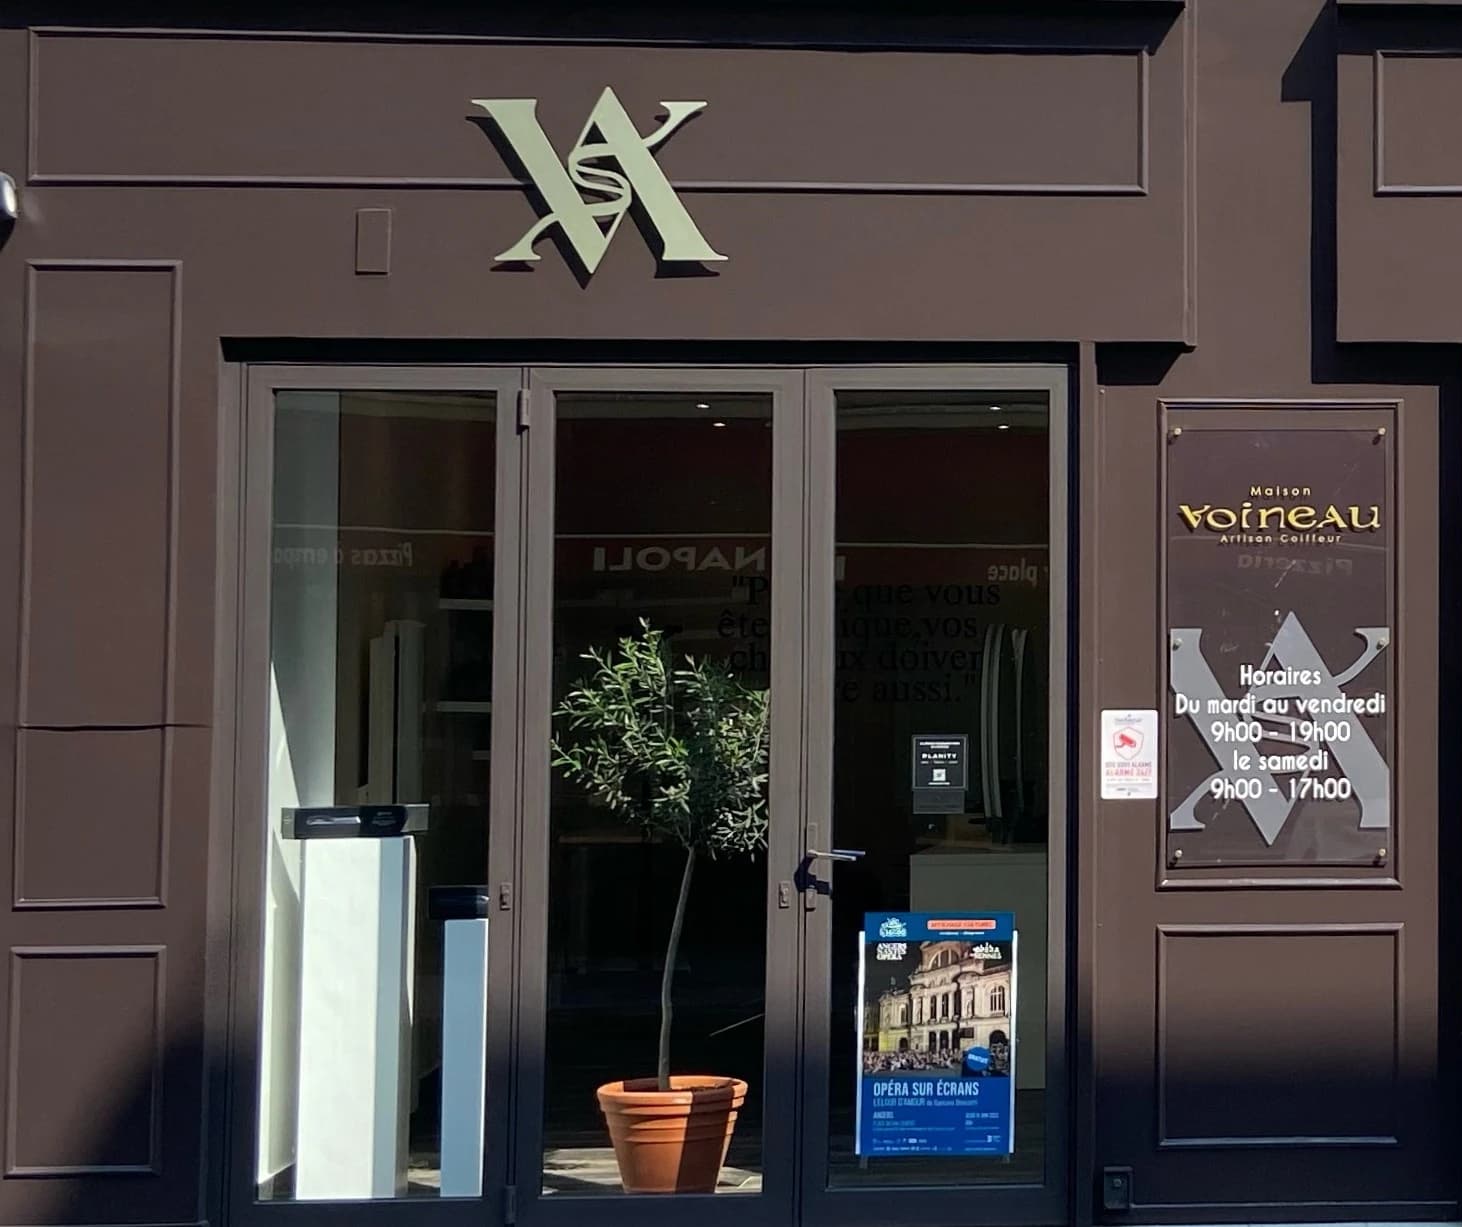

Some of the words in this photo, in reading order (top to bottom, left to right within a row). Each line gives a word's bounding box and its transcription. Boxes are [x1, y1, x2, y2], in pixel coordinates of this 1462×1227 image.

[1250, 486, 1312, 497] Maison
[1220, 534, 1273, 544] Artisan
[1280, 534, 1342, 544] Coiffeur
[926, 584, 1001, 606] vous
[1240, 665, 1322, 686] Horaires
[1175, 693, 1200, 714] Du
[1207, 693, 1256, 714] mardi
[1262, 699, 1289, 714] au
[1296, 692, 1386, 714] vendredi
[1210, 721, 1263, 742] 9h00
[1290, 721, 1351, 742] 19h00
[1233, 749, 1251, 770] le
[1258, 749, 1328, 770] samedi
[1210, 778, 1262, 799] 9h00
[1289, 778, 1351, 799] 17h00
[873, 1079, 909, 1097] OPÉRA
[912, 1082, 934, 1097] SUR
[937, 1079, 980, 1097] ÉCRANS
